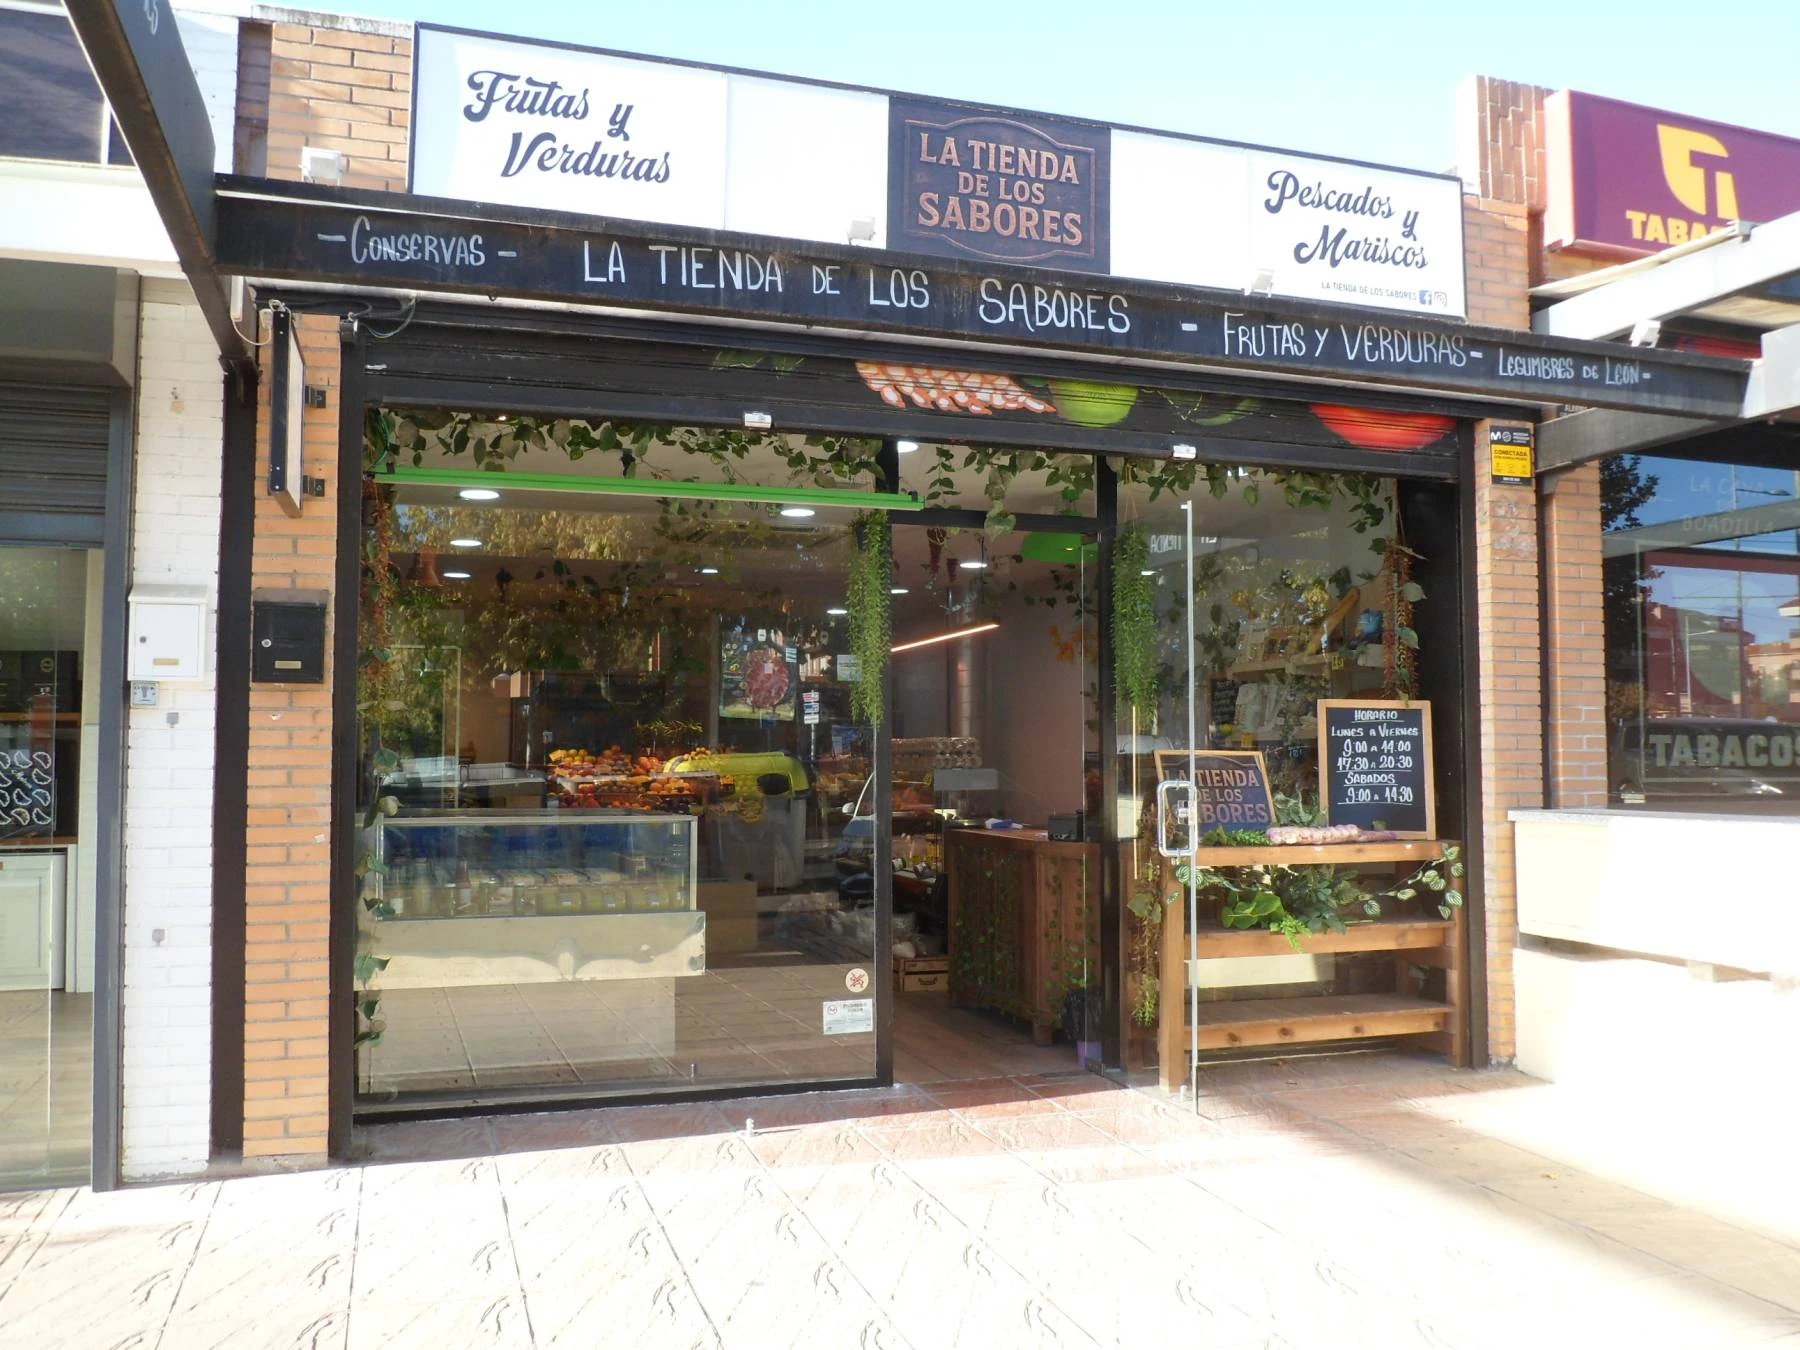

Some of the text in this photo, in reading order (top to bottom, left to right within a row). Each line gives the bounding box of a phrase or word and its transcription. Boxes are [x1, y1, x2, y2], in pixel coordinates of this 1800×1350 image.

[463, 70, 634, 141] Frutas y
[500, 131, 671, 183] Verduras
[919, 132, 1080, 185] LA TIENDA
[958, 171, 1045, 205] DE LOS
[918, 191, 1082, 246] SABORES
[1264, 170, 1419, 241] Pescados y
[1294, 225, 1428, 269] Mariscos
[351, 215, 486, 267] CONSERVAS
[584, 240, 626, 283] LA
[649, 245, 783, 293] TIENDA
[812, 265, 841, 295] DE
[869, 268, 930, 309] LOS
[979, 278, 1131, 334] SABORES
[1224, 312, 1306, 357] FRUTAS
[1314, 328, 1329, 357] Y
[1340, 324, 1467, 367] VERDURAS
[1499, 348, 1575, 380] LEGUMBRES
[1582, 365, 1599, 379] DE
[1321, 281, 1417, 300] LA TIENDA DE LOS SABORES
[1331, 725, 1364, 737] LUNES
[1378, 722, 1419, 738] VIERNES
[1354, 709, 1398, 721] HORARIO
[1194, 769, 1260, 787] TIENDA
[1216, 788, 1243, 802] LOS
[1345, 773, 1395, 785] SABADOS
[1196, 803, 1268, 824] BORES
